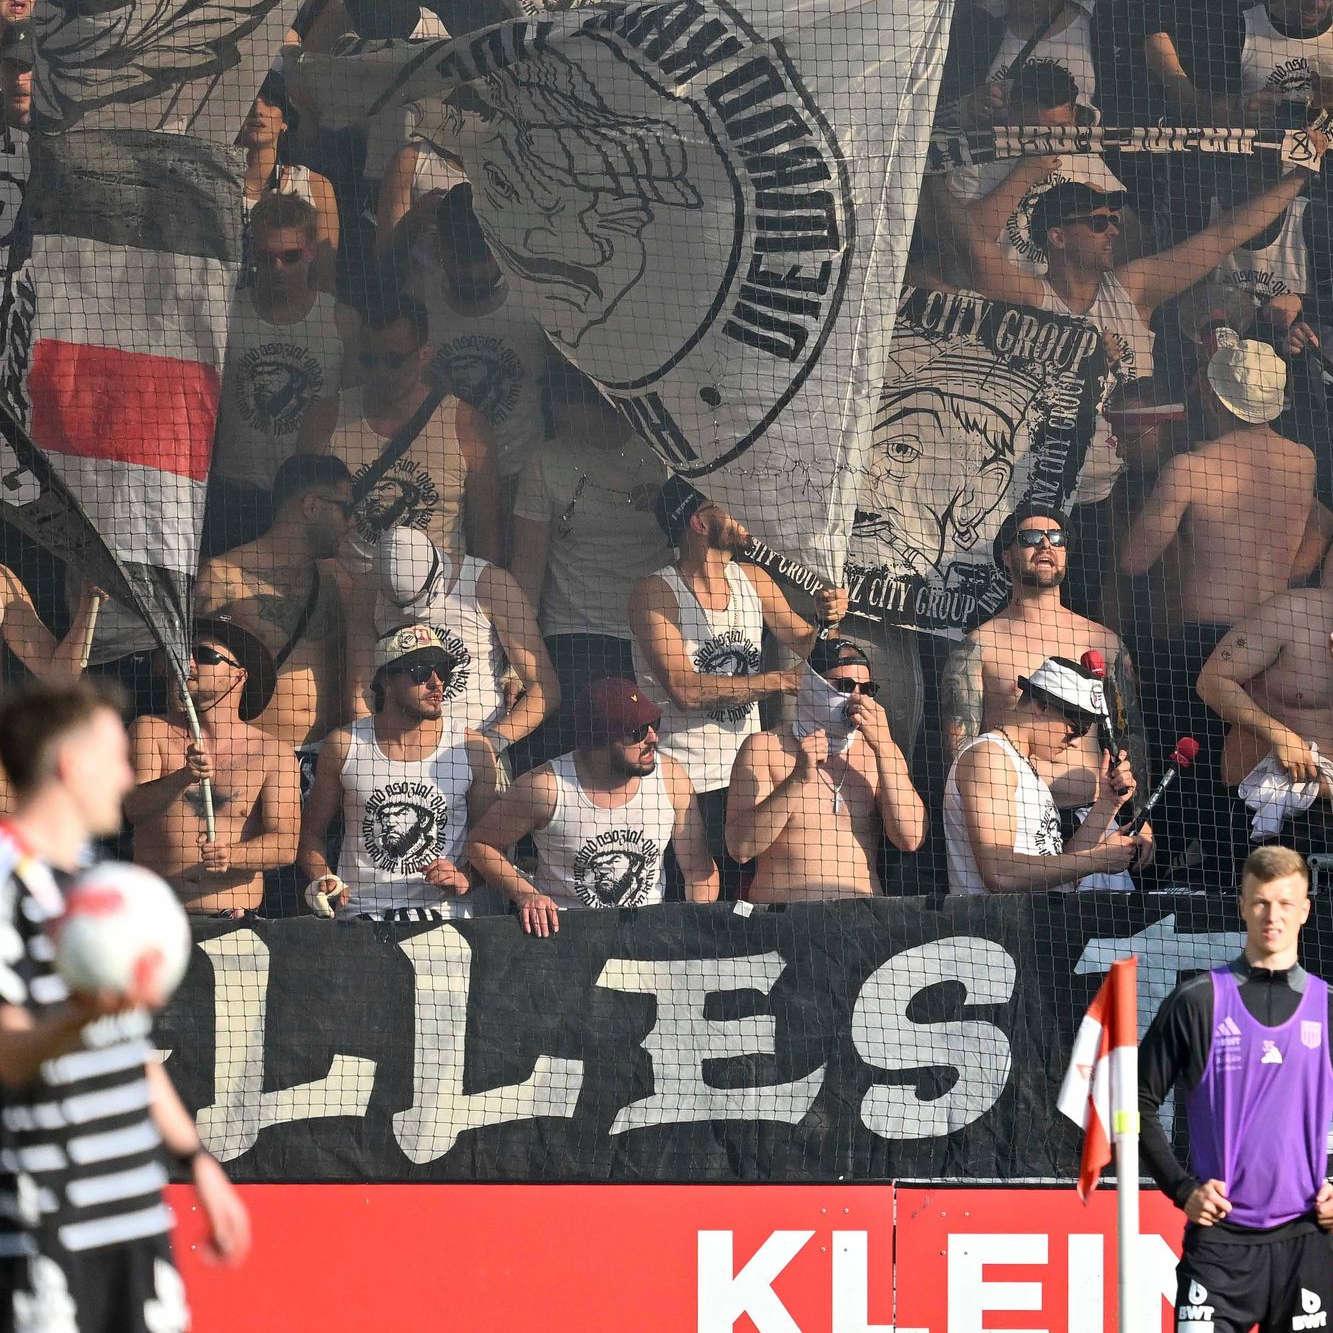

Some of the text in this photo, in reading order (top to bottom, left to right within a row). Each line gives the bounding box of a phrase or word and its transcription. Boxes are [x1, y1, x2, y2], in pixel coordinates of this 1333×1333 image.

[921, 289, 1099, 373] CITY GROUP
[1030, 475, 1055, 508] INZ
[870, 575, 912, 612] CITY
[916, 586, 976, 624] GROUP
[180, 924, 1018, 1164] LLES
